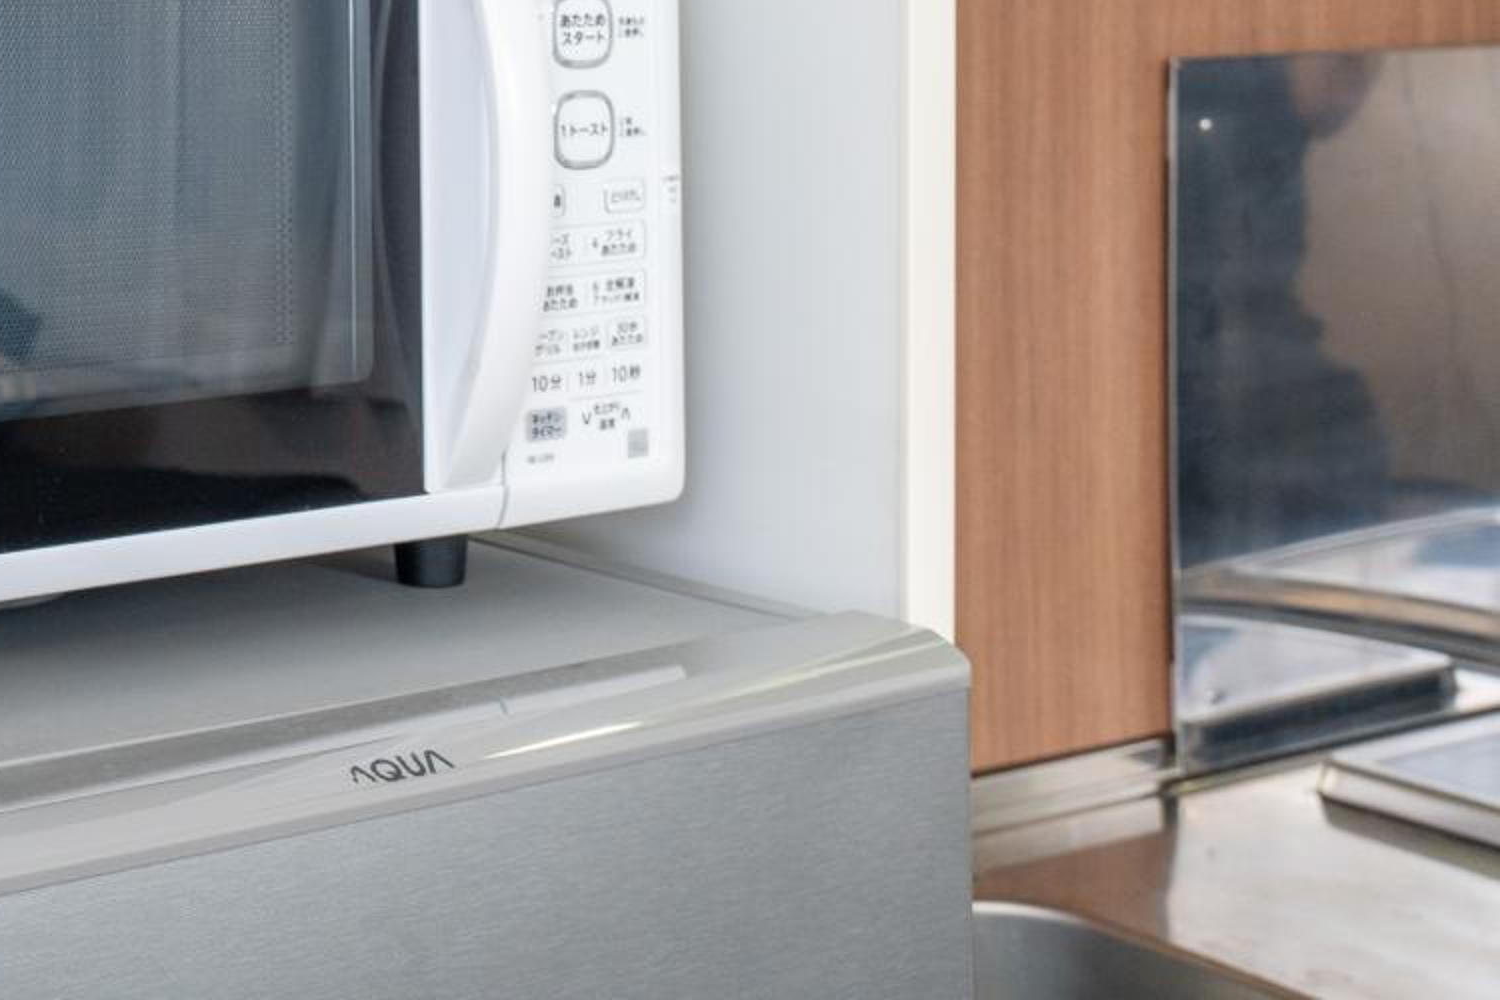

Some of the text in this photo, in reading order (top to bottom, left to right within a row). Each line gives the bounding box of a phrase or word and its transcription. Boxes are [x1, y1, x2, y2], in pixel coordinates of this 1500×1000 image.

[560, 12, 606, 29] あたため
[561, 30, 606, 46] スタート
[578, 370, 597, 387] 1分
[612, 364, 642, 383] 10秒
[531, 374, 562, 393] 10分
[350, 749, 456, 784] AQUA
